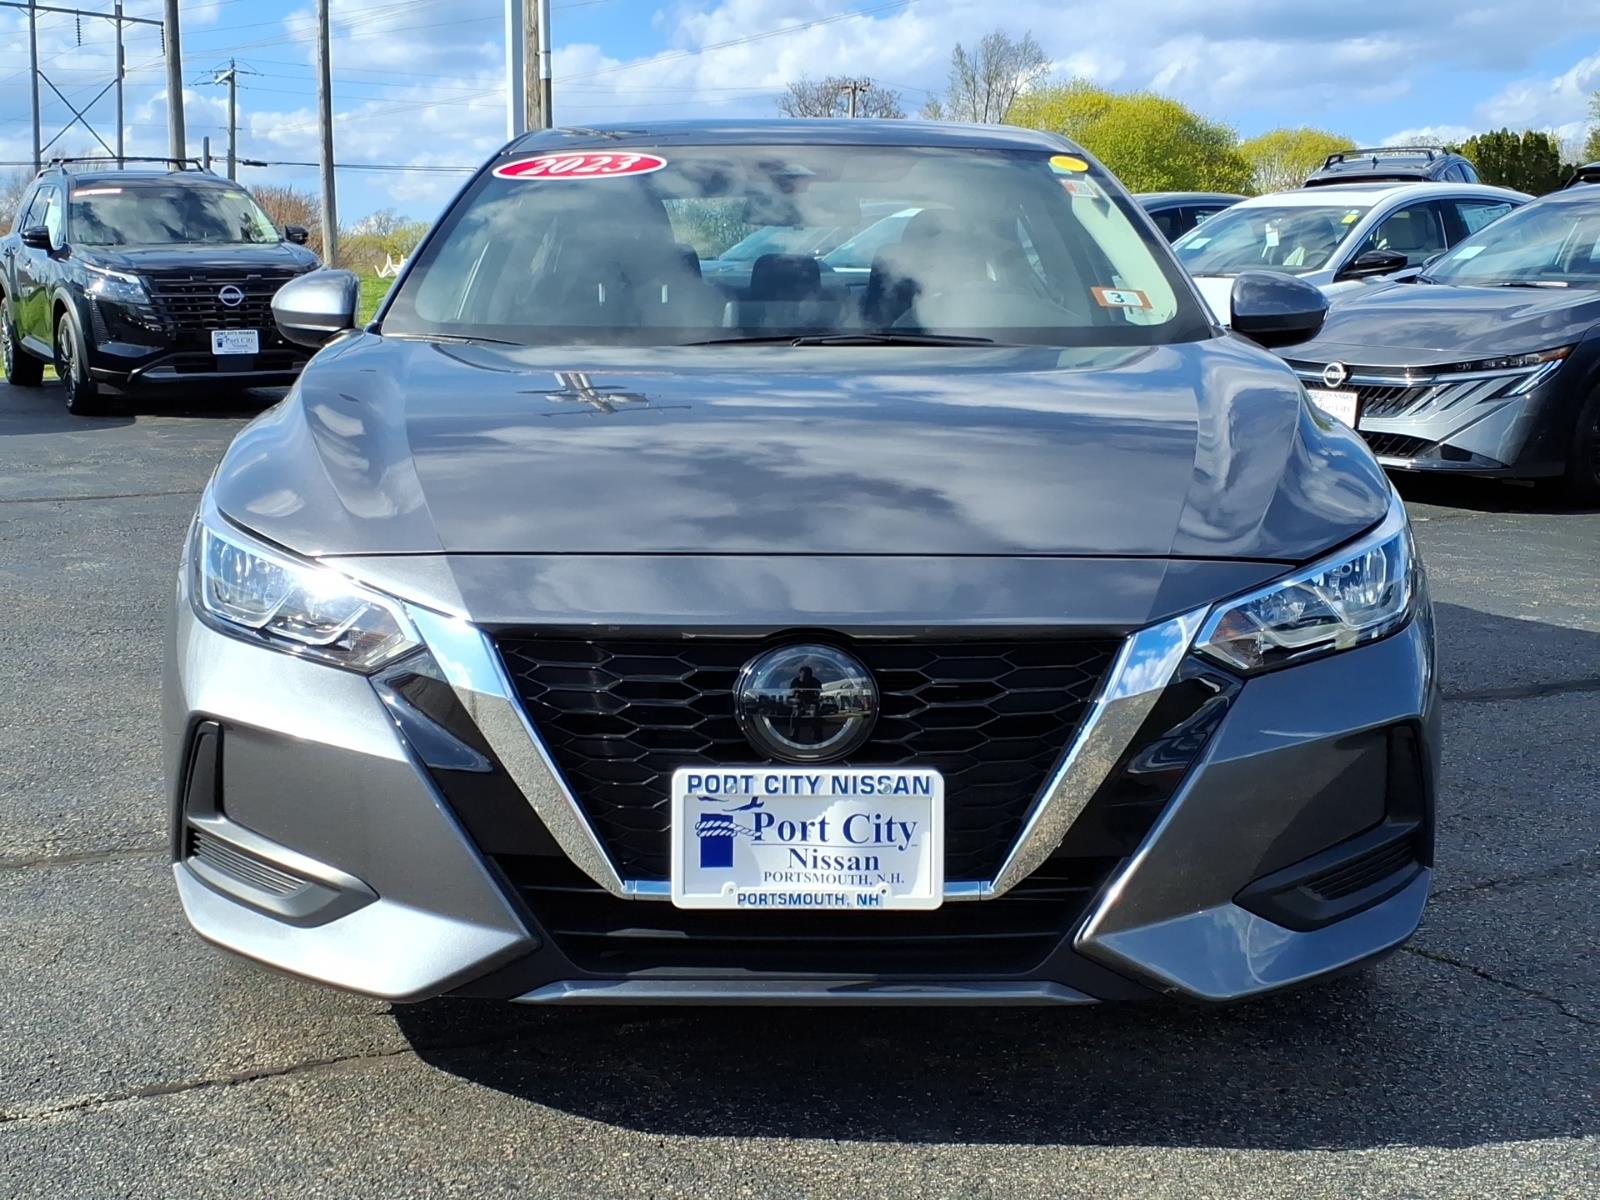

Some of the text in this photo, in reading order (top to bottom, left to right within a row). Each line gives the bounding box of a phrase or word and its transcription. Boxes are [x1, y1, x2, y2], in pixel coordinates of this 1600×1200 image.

[516, 156, 641, 176] 2023
[1110, 292, 1125, 304] 3
[687, 775, 930, 794] PORT CITY NISSAN
[753, 812, 918, 851] Port City
[788, 848, 879, 870] Nissan
[763, 871, 904, 886] PORTSMOUTH, N.H.
[737, 892, 879, 907] PORTSMOUTH, NH
